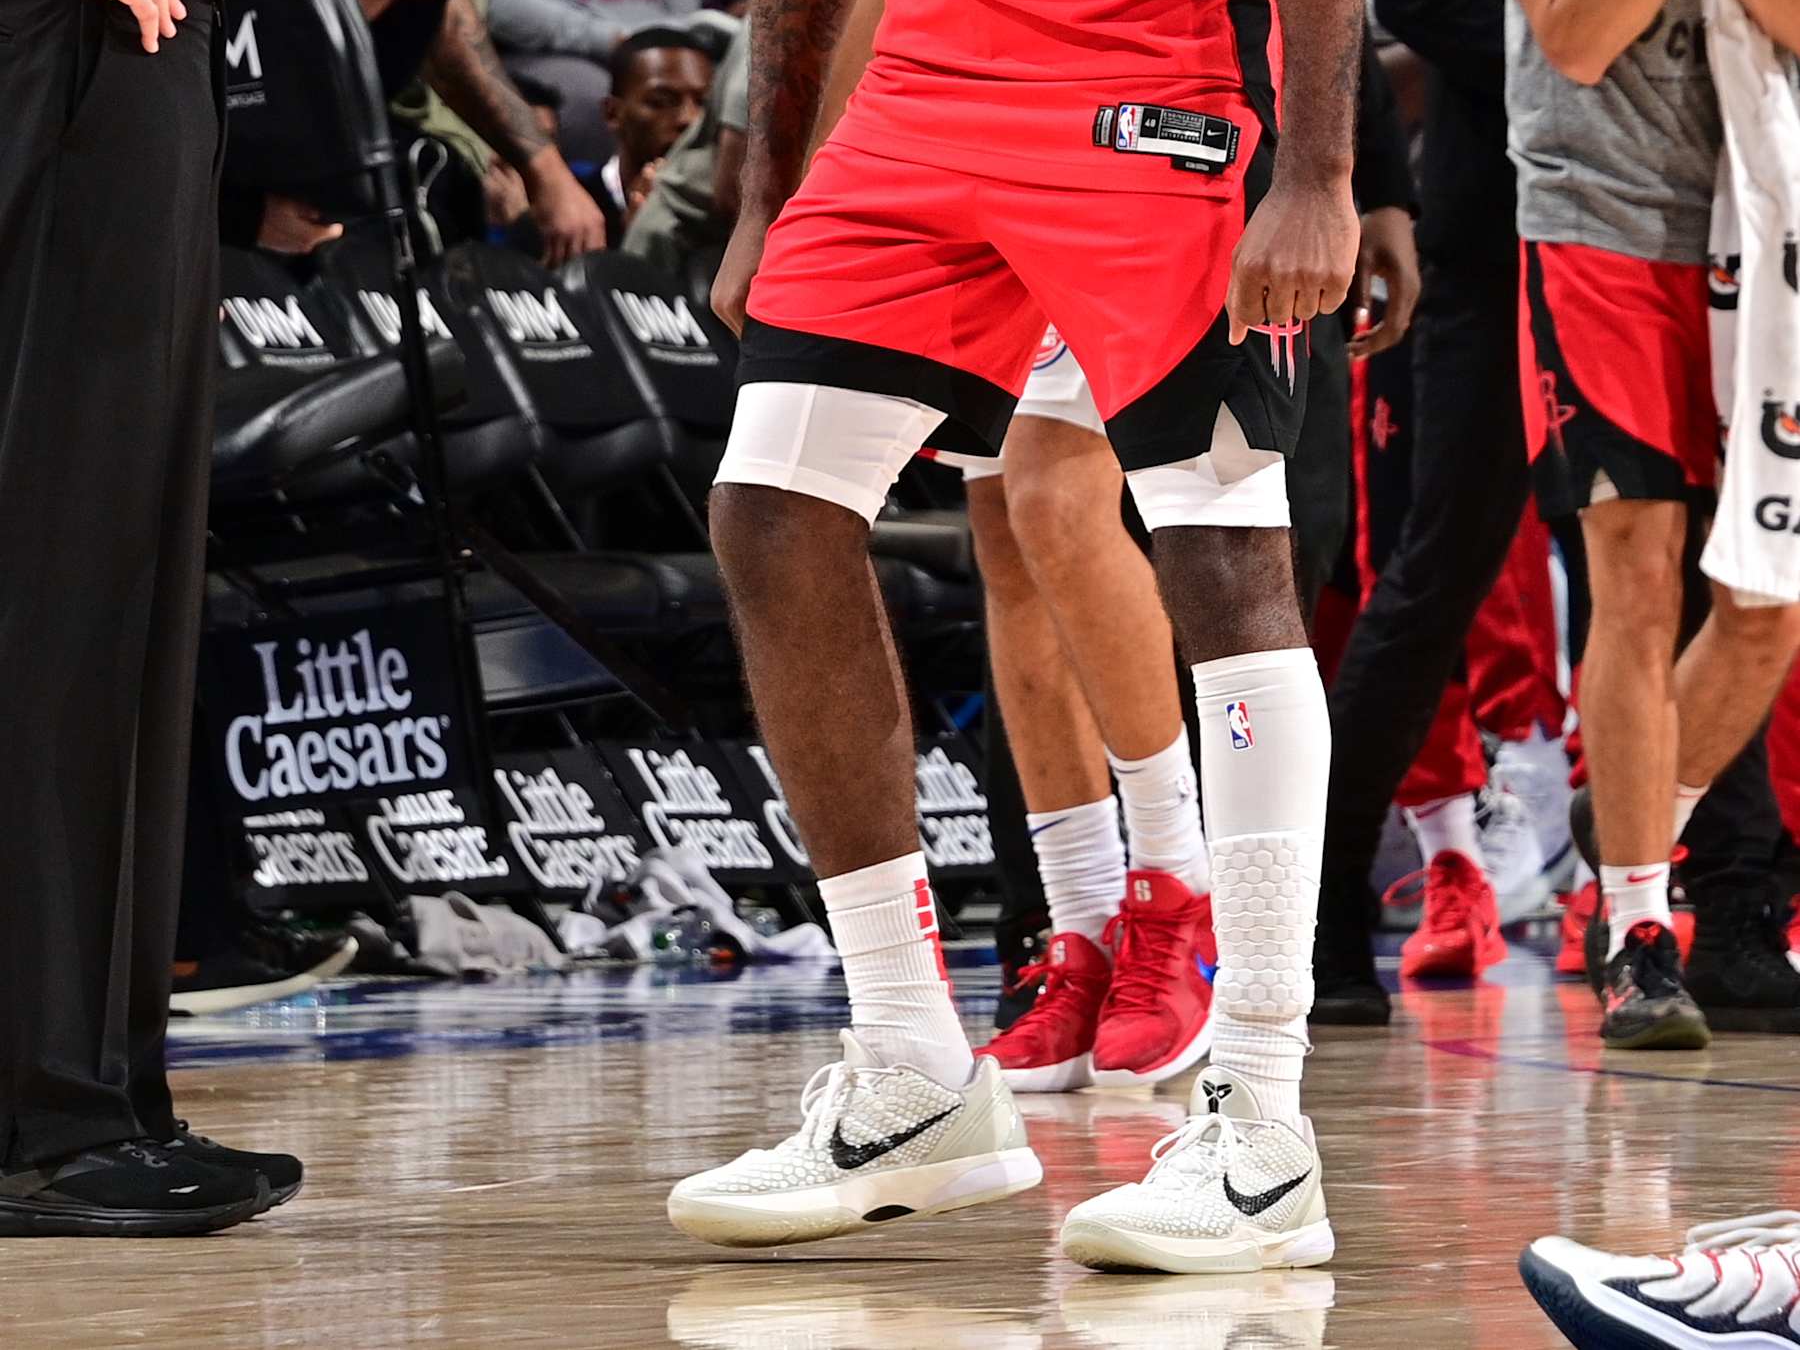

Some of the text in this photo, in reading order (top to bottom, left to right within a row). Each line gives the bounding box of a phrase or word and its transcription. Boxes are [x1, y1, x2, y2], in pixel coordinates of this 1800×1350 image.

[253, 628, 413, 725] Little
[225, 714, 449, 801] Caesars
[627, 748, 732, 815] Little
[494, 768, 605, 834] Little
